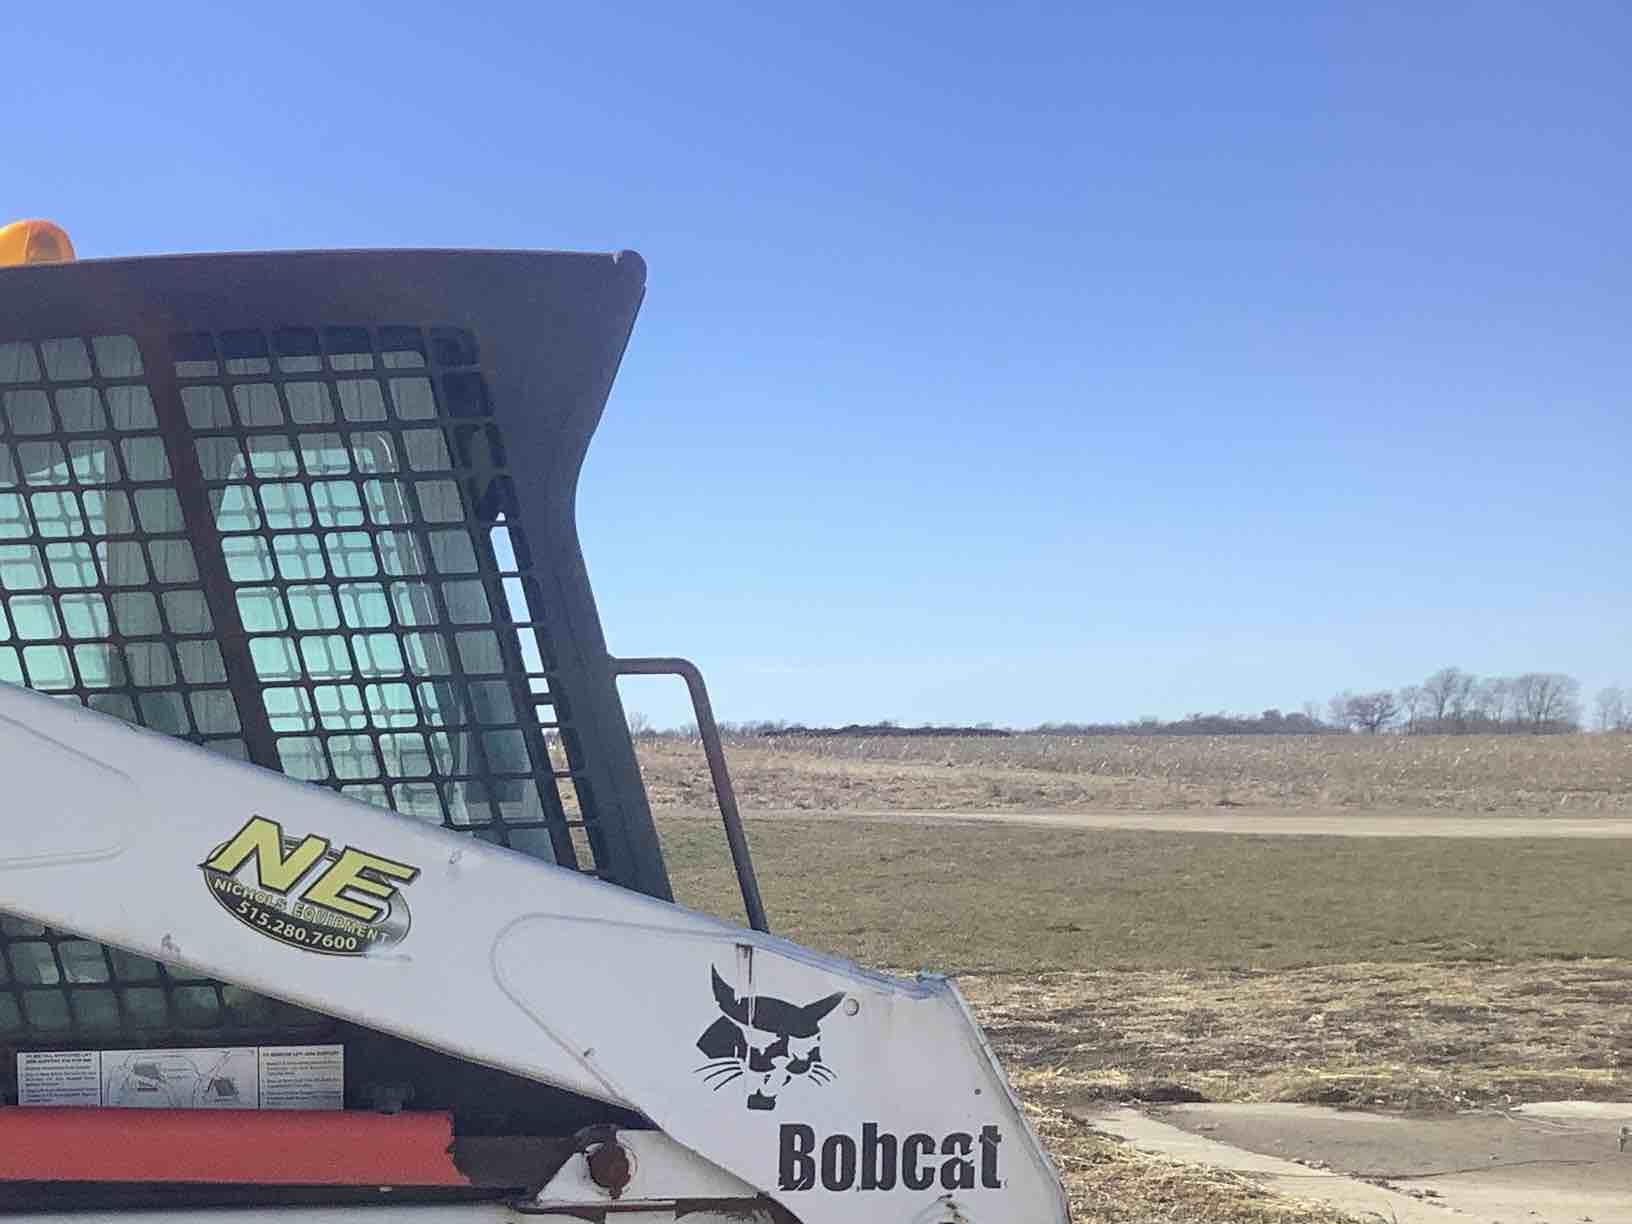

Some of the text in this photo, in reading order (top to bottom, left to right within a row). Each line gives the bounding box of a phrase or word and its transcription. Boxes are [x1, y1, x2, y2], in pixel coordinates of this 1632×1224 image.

[204, 813, 422, 924] NE
[213, 877, 390, 945] NICHOLS EQUIPMENT
[235, 900, 358, 951] 515.280.7600
[778, 1122, 1002, 1192] Bobcat
